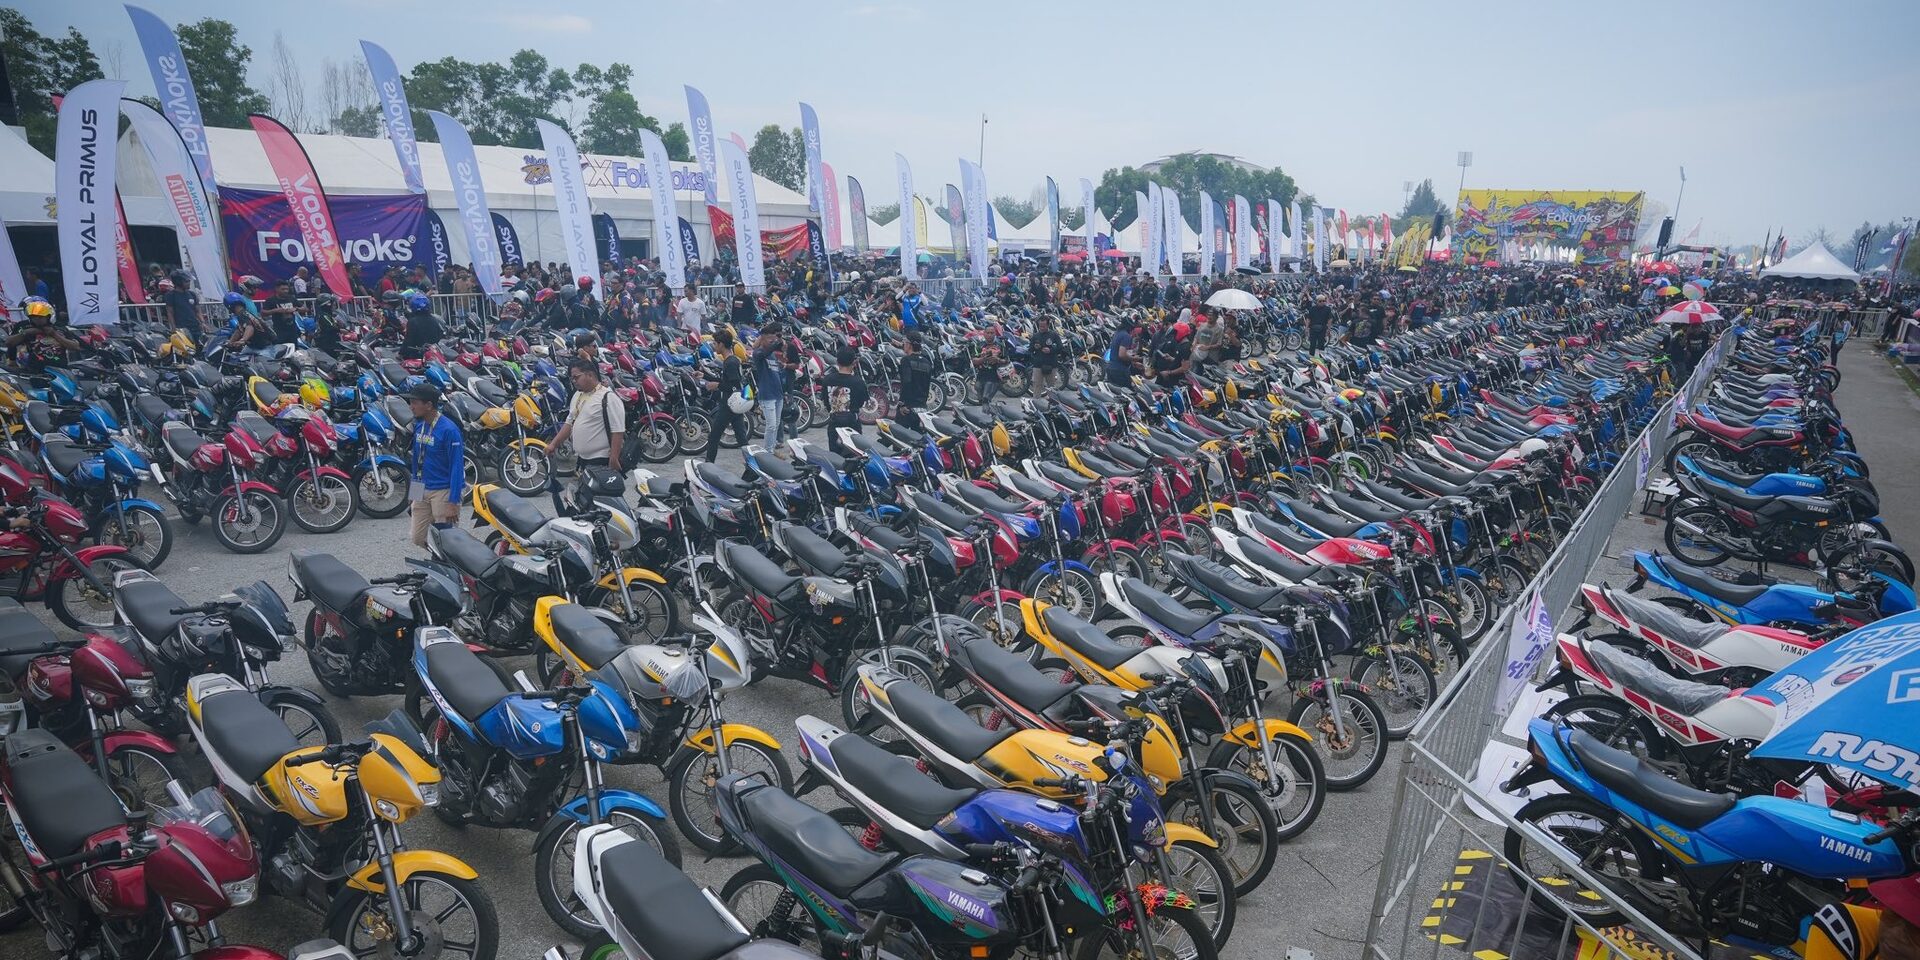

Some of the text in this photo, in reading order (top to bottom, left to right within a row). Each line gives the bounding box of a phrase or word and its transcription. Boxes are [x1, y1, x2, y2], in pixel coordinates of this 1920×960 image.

[79, 108, 98, 286] LOYAL PRIMUS
[1546, 211, 1602, 226] Fokiyoks
[1796, 480, 1816, 489] YAMAHA
[1807, 505, 1829, 514] YAMAHA
[512, 562, 529, 575] YAMAHA
[1780, 643, 1809, 657] YAMAH
[647, 659, 670, 679] YAMAHA
[1725, 784, 1743, 793] YAMAHA
[1819, 835, 1873, 864] YAMAHA
[947, 890, 985, 920] YAMAHA
[1737, 917, 1759, 929] YAMAHA
